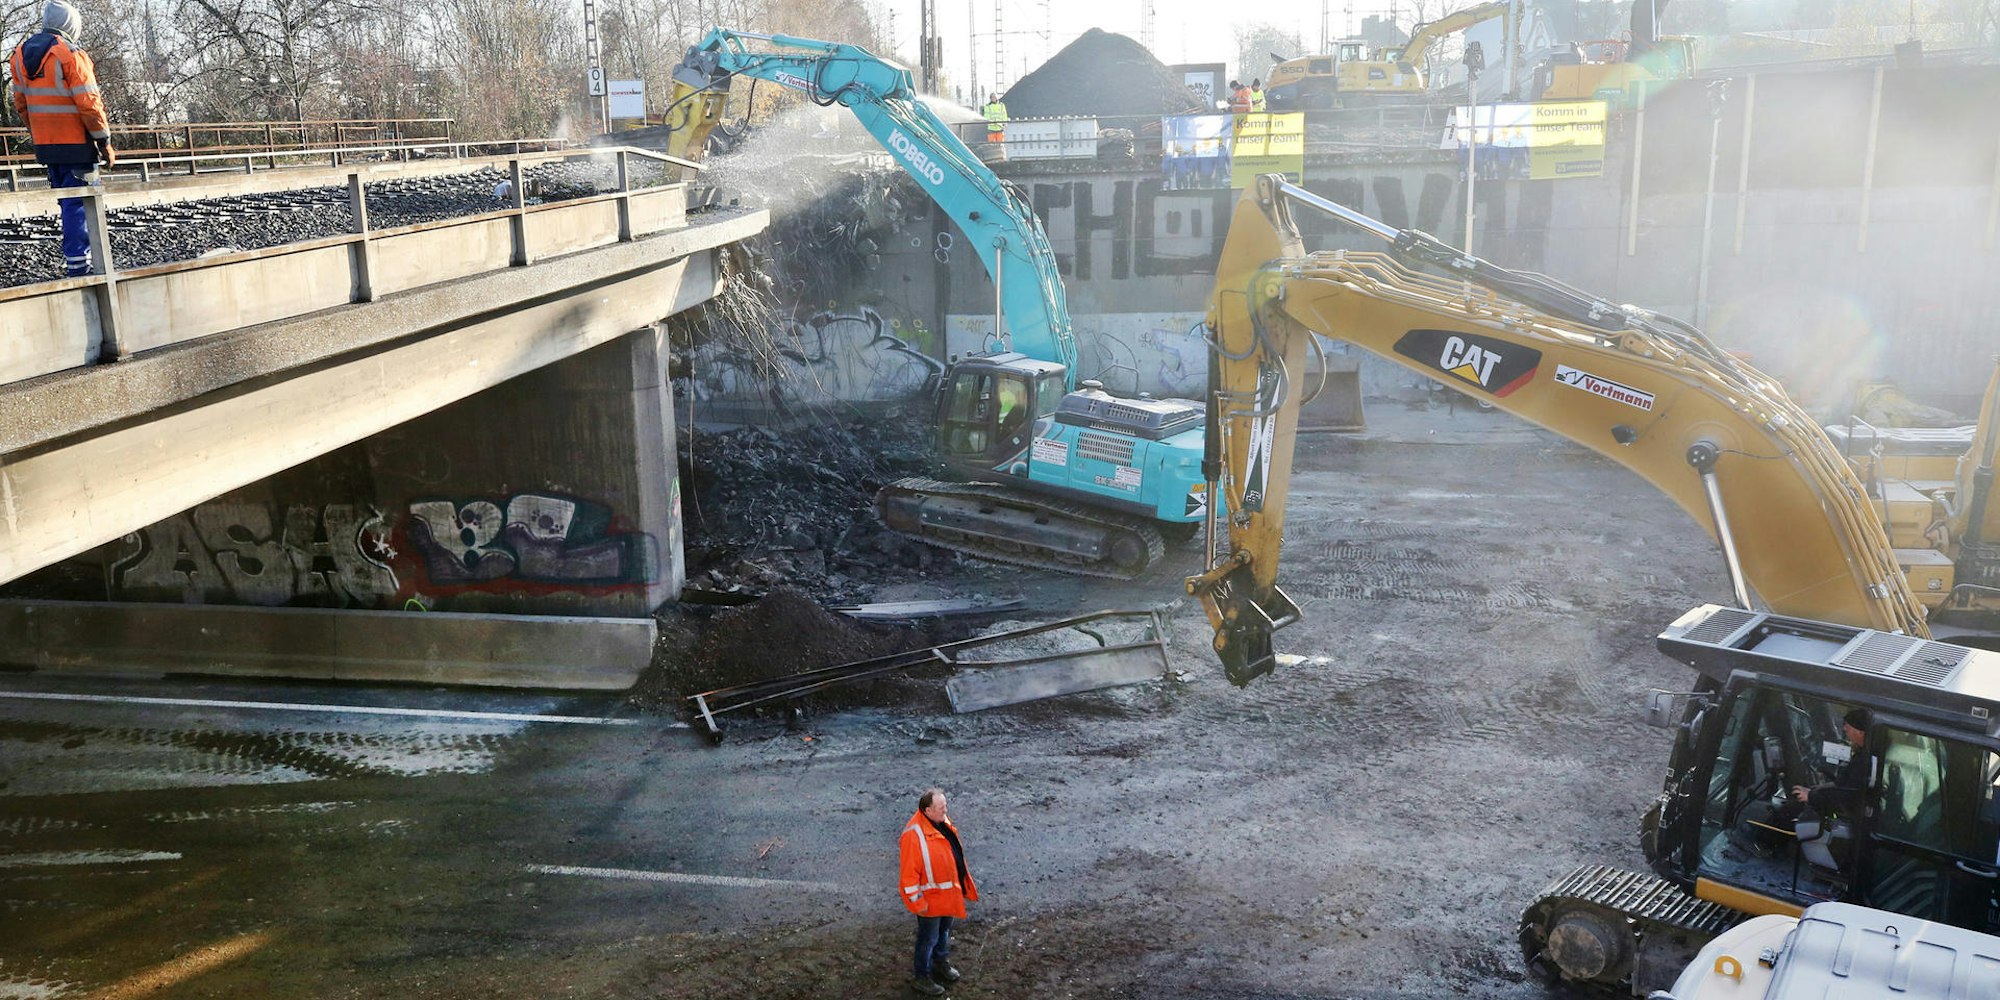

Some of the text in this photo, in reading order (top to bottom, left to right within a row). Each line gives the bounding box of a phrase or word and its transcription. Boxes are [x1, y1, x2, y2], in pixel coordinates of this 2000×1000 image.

[592, 69, 600, 80] 0
[593, 81, 601, 93] 4
[1536, 106, 1587, 117] Komm in
[1236, 118, 1284, 129] Komm in
[1536, 123, 1566, 132] unser
[1236, 132, 1300, 145] unser Team!
[887, 128, 944, 186] KOBELCO
[1439, 336, 1502, 387] CAT
[1585, 376, 1652, 410] Vortmann
